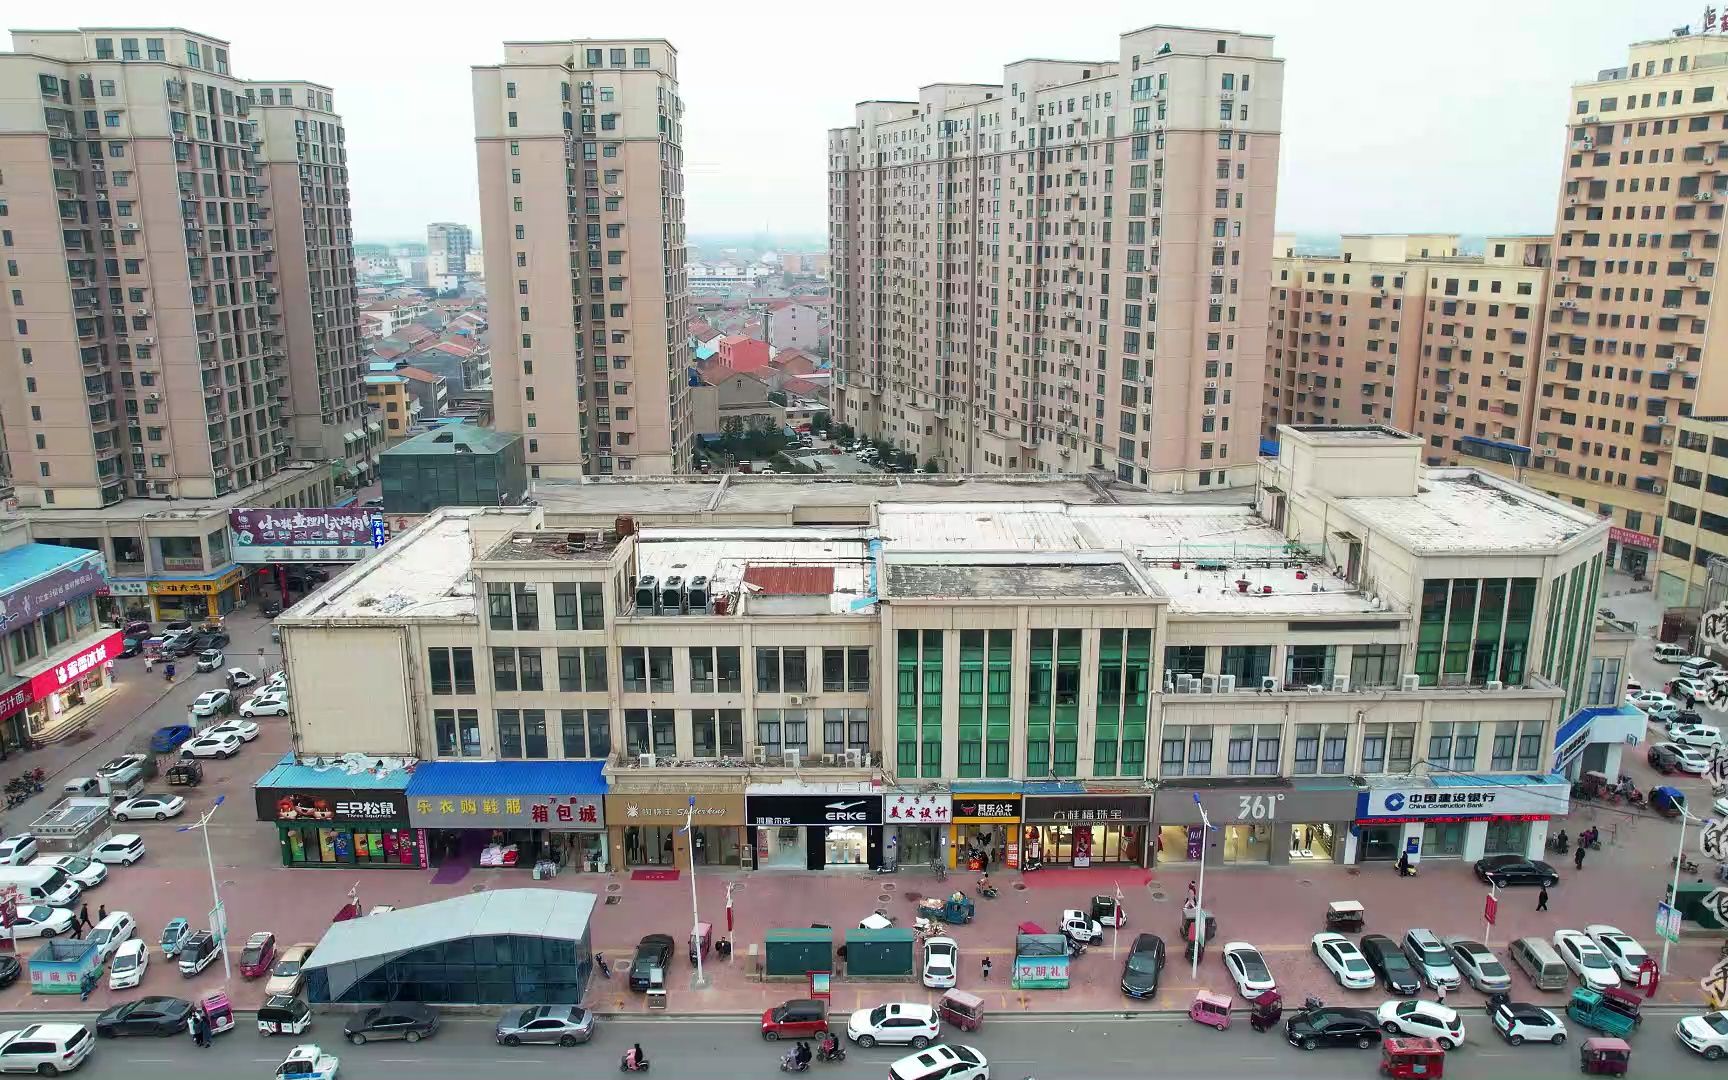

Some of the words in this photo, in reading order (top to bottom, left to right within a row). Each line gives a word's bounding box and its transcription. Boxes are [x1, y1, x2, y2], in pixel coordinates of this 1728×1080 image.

[67, 644, 107, 679] 蜜雪冰城
[1409, 792, 1496, 803] 中国建设银行
[336, 801, 396, 815] 三只松鼠
[417, 798, 522, 815] 乐衣购鞋服
[532, 804, 597, 823] 箱包城
[889, 805, 948, 819] 美发设计
[1238, 794, 1285, 820] 361°
[825, 811, 867, 821] ERKE
